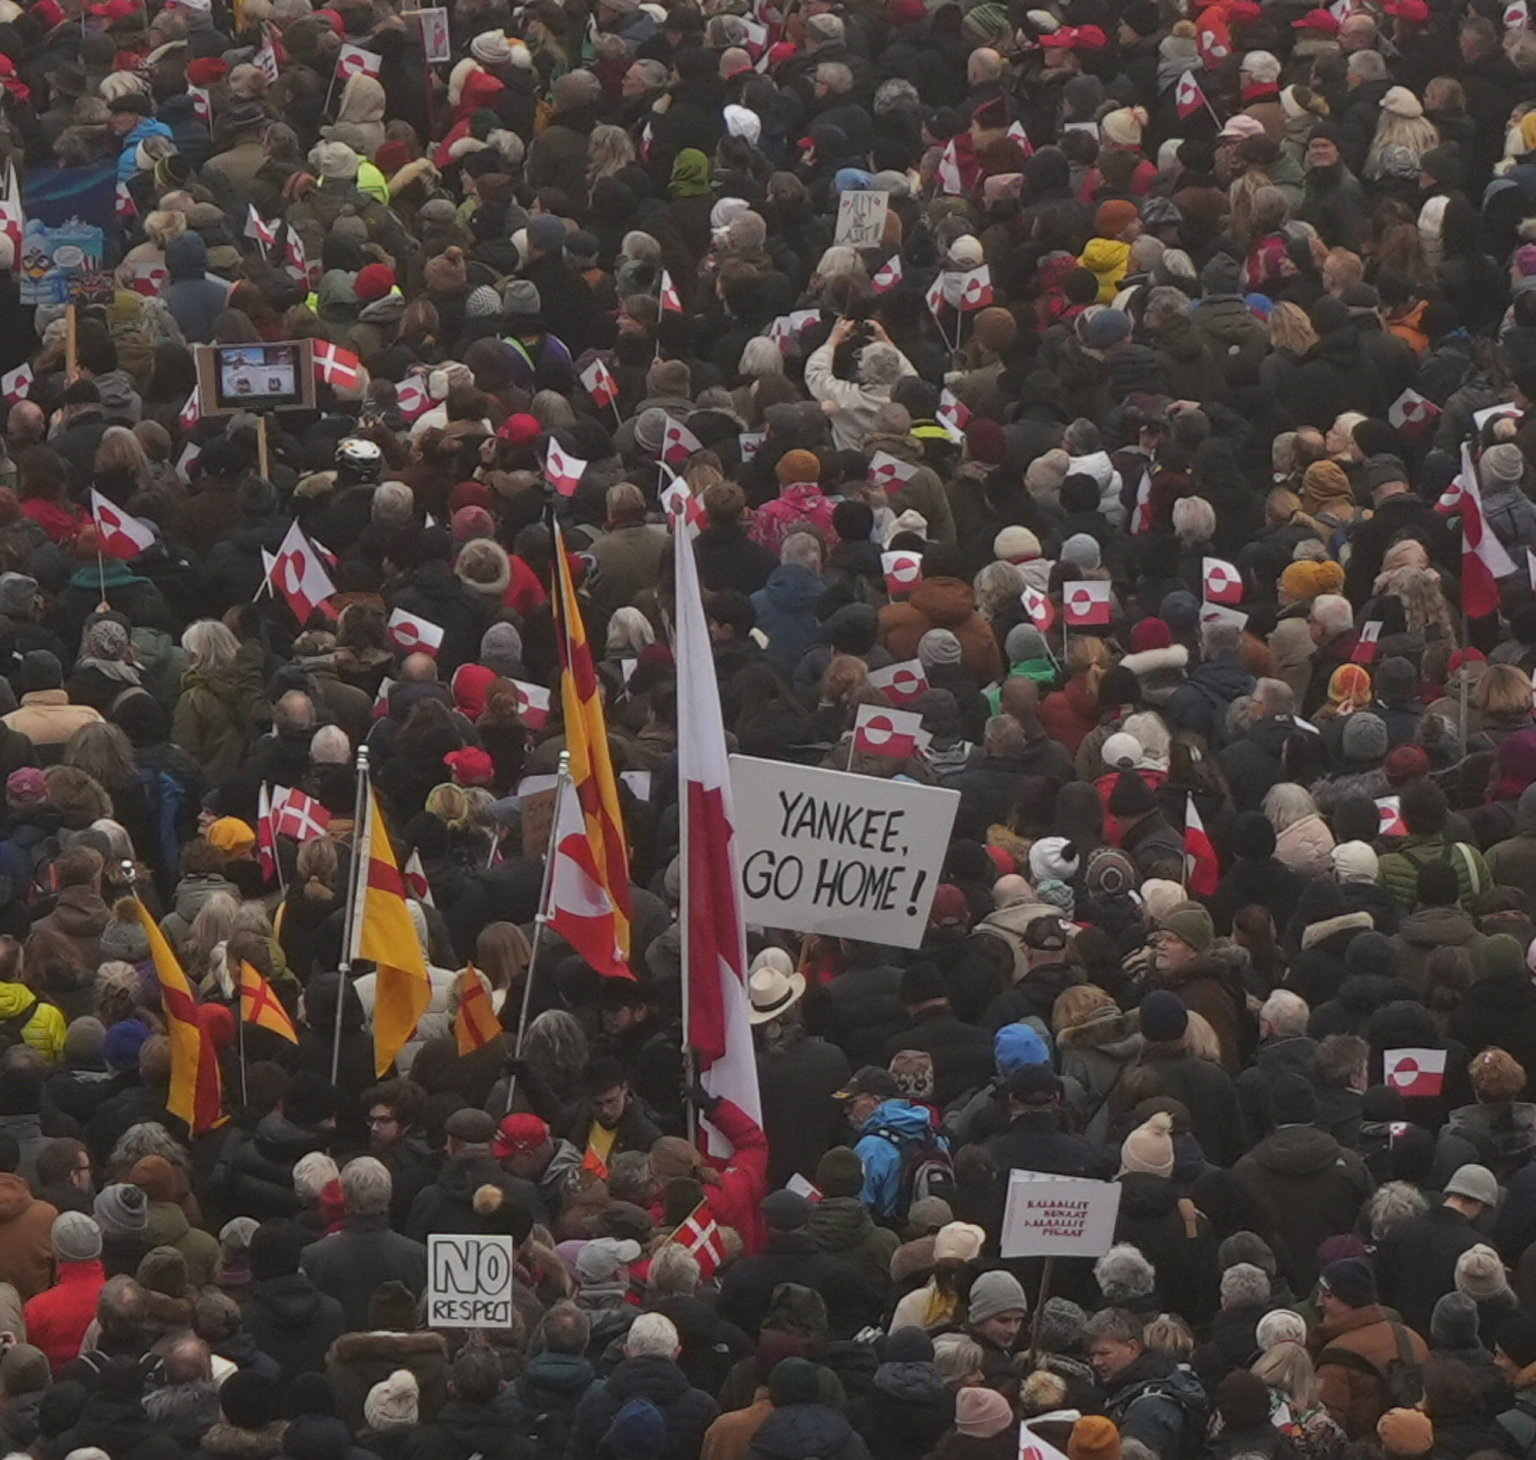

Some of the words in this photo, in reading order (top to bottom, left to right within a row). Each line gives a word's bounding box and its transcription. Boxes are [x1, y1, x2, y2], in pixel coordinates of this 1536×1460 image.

[779, 790, 908, 856] YANKEE,
[742, 850, 804, 901] GO
[433, 1240, 510, 1296] NO
[433, 1300, 510, 1322] RESPECT
